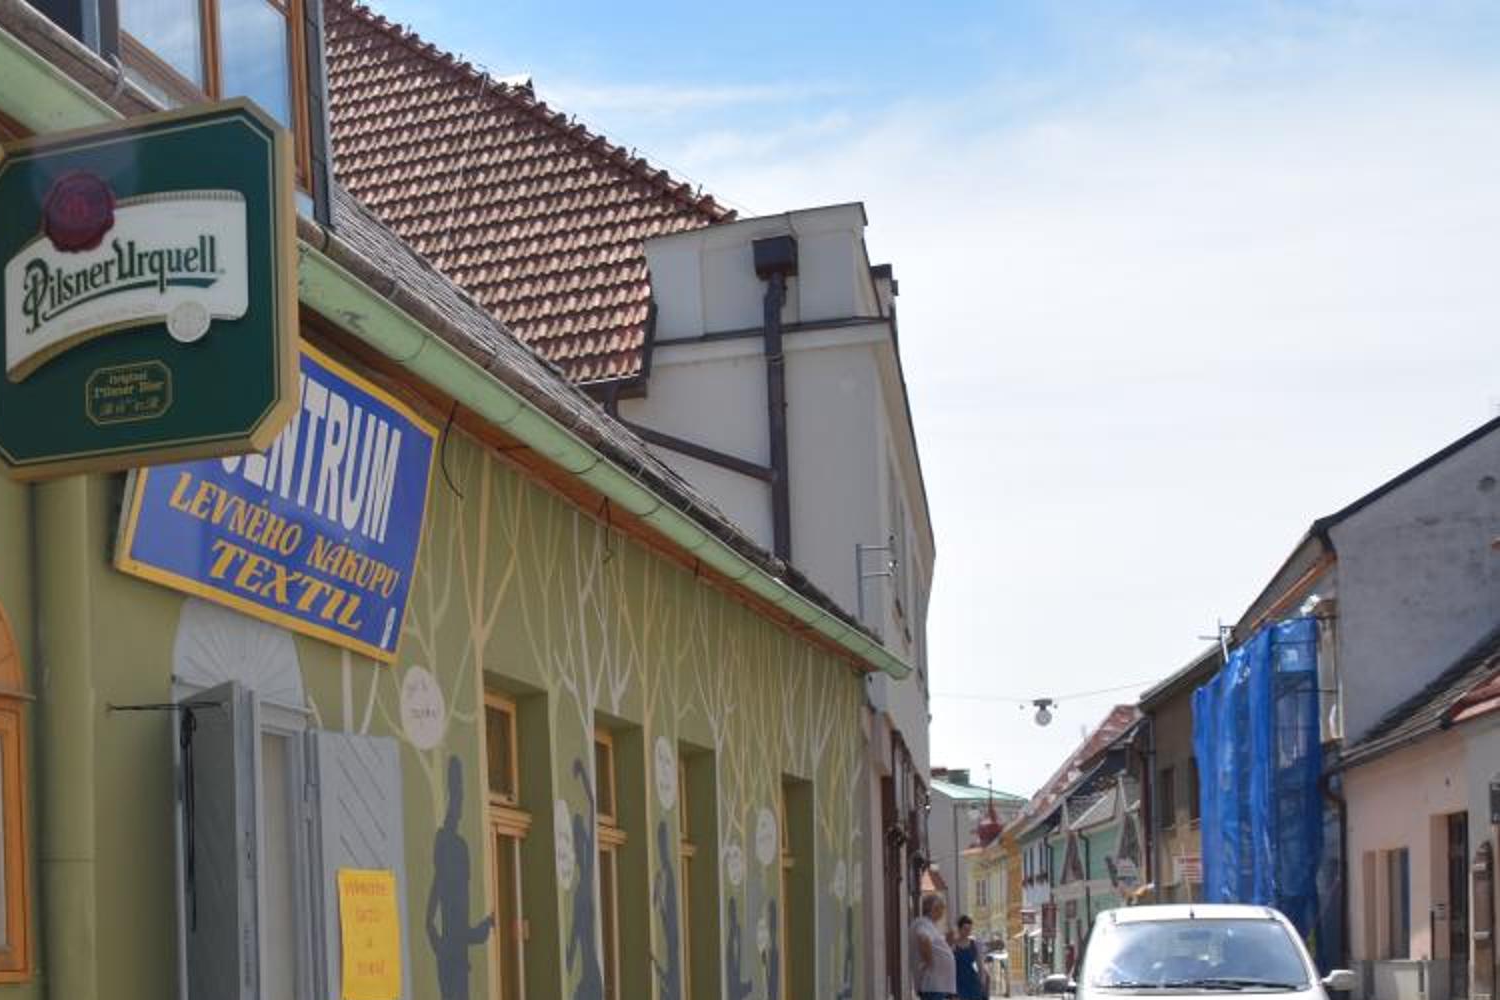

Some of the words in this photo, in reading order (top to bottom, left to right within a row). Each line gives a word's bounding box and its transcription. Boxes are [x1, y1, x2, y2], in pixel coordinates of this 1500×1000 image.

[22, 257, 118, 335] Pilsner
[113, 235, 216, 293] Urquell
[221, 372, 402, 543] NTRUM
[168, 472, 303, 556] LEVNÉHO
[307, 534, 398, 598] NÁKUPU
[209, 538, 363, 630] TEXTIL
